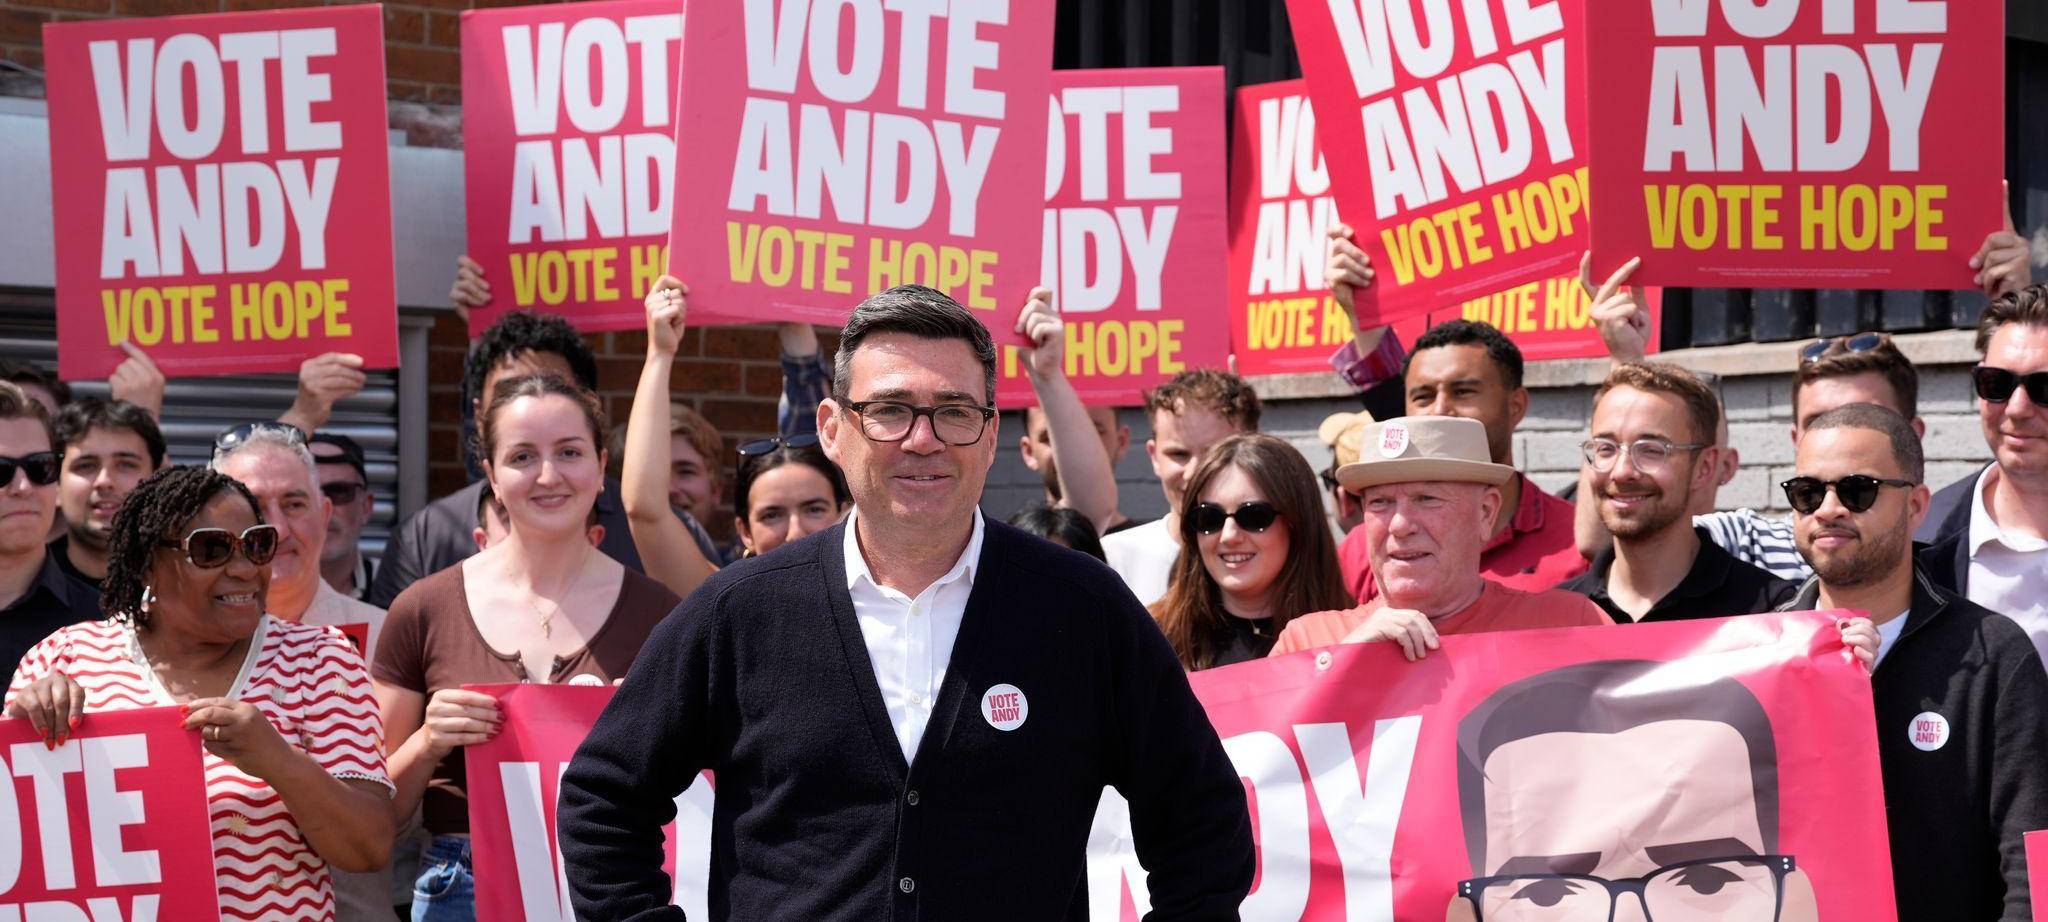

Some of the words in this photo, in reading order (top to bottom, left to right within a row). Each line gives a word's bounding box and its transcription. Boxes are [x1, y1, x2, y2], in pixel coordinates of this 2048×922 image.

[89, 27, 342, 161] VOTE
[743, 0, 1009, 120] VOTE
[1045, 85, 1182, 202] TE
[1361, 38, 1574, 221] ANDY
[1643, 42, 1944, 172] ANDY
[727, 96, 1001, 238] ANDY
[100, 157, 340, 280] ANDY
[1380, 200, 1493, 286] VOTE
[1644, 183, 1783, 250] VOTE
[1800, 184, 1948, 251] HOPE
[508, 247, 620, 306] VOTE
[726, 221, 854, 294] VOTE
[868, 237, 998, 310] HOPE
[101, 285, 219, 346] VOTE
[230, 278, 352, 341] HOPE
[1064, 320, 1186, 377] HOPE
[1247, 297, 1317, 350] VOTE
[1386, 427, 1404, 440] VOTE
[988, 692, 1020, 709] VOTE
[991, 708, 1020, 722] ANDY
[1915, 732, 1942, 743] ANDY
[1916, 720, 1944, 732] VOTE
[0, 733, 162, 896] TE
